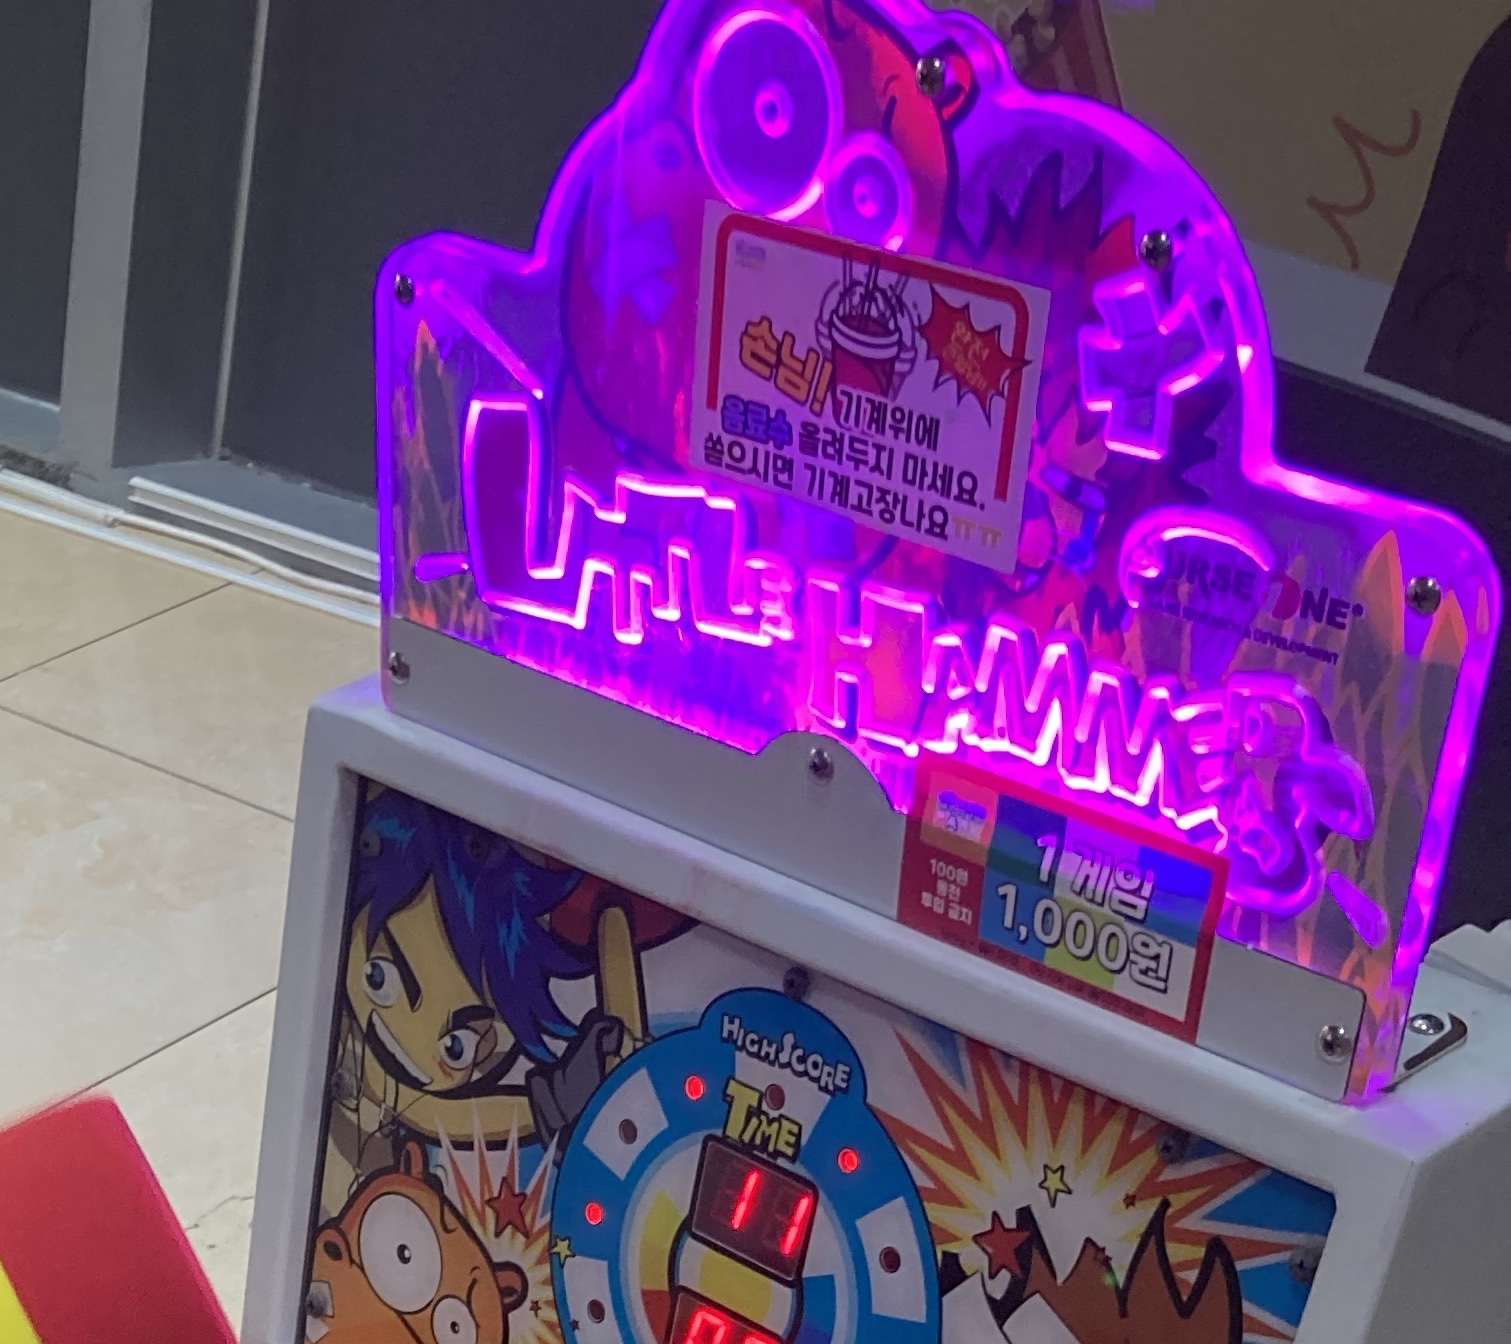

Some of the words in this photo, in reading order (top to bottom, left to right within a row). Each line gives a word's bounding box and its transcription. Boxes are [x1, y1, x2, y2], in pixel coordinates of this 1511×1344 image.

[740, 316, 833, 416] 손님!
[721, 394, 793, 449] 음료수
[798, 421, 894, 480] 올려두지
[902, 453, 985, 510] 마세요.
[839, 390, 940, 451] 기계위에
[997, 883, 1174, 994] 1,000원
[726, 1078, 802, 1162] TIME
[730, 1169, 812, 1256] 11
